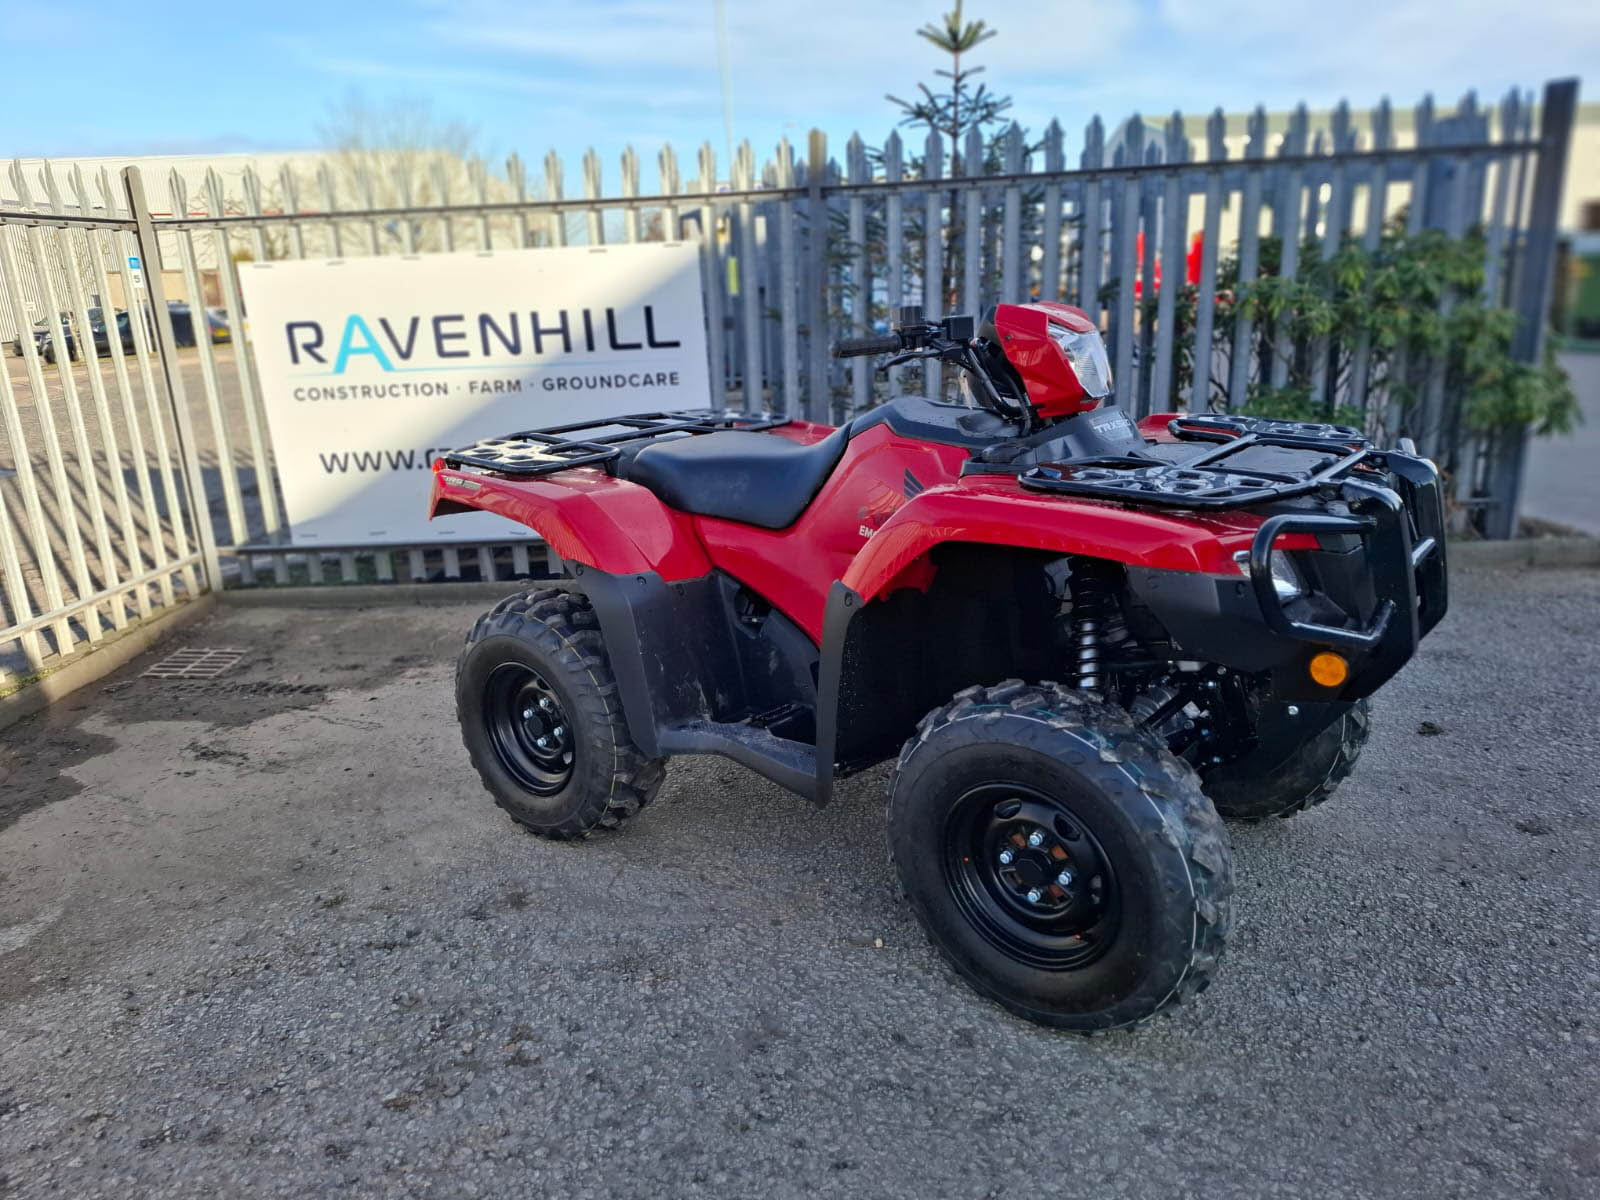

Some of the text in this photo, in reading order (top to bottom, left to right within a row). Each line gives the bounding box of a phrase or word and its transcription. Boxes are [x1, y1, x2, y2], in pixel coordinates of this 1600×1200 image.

[285, 305, 681, 375] RAVENHILL
[293, 371, 680, 401] CONSTRUCTION FARM GROUNDCARE
